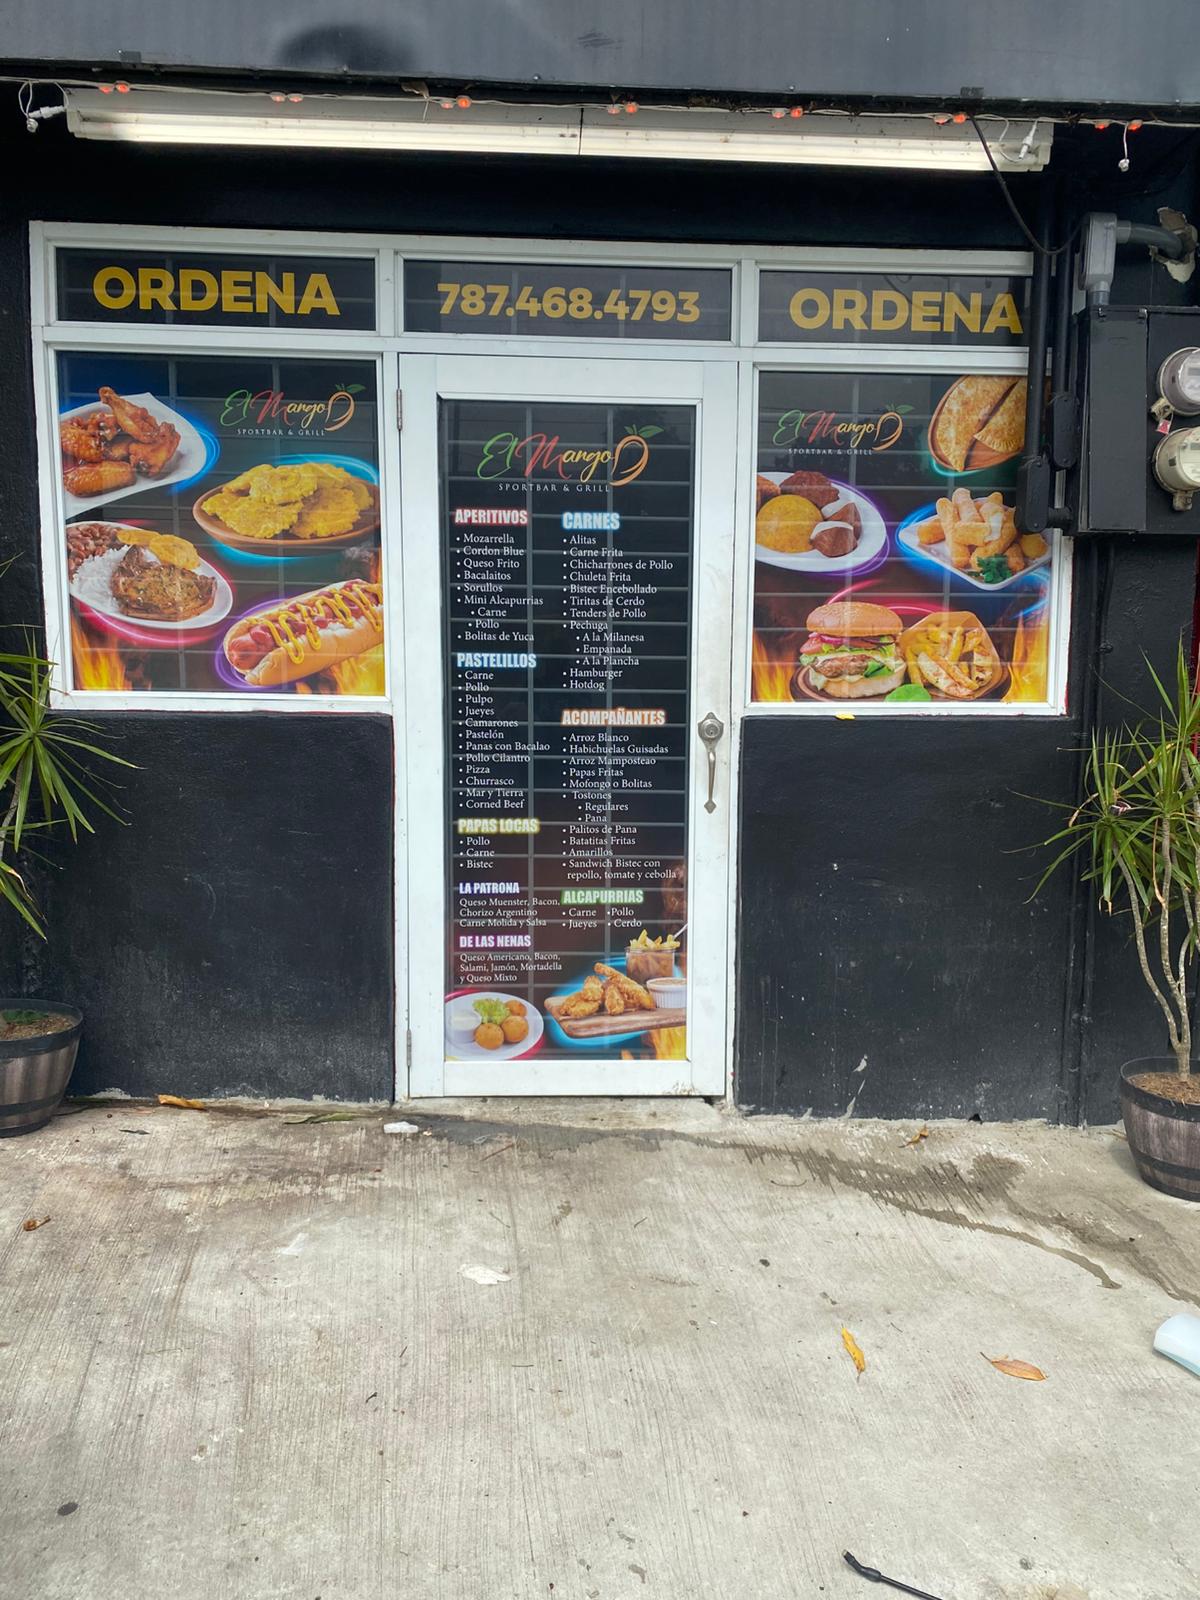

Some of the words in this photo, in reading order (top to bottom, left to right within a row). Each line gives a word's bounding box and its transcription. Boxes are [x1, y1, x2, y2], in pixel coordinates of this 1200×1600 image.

[93, 266, 340, 316] ORDENA
[437, 283, 700, 322] 787.468.4793
[789, 288, 1024, 334] ORDENA
[220, 389, 252, 426] El
[250, 390, 326, 429] Mango
[773, 409, 805, 446] El
[802, 410, 875, 448] Mango
[477, 432, 518, 480] El
[515, 433, 613, 482] Mango
[499, 483, 557, 491] SPORTBAR
[577, 484, 609, 492] GRILL
[455, 509, 528, 524] APERITIVOS
[562, 512, 620, 529] CARNES
[463, 534, 514, 543] Mozarrella
[570, 535, 596, 544] Alitas
[463, 546, 500, 555] Cordon
[503, 546, 524, 556] Blue
[570, 548, 598, 557] Carne
[602, 548, 623, 557] Frita
[463, 559, 494, 569] Queso
[497, 559, 520, 568] Frito
[570, 560, 632, 569] Chicharrones
[636, 561, 646, 569] de
[650, 560, 673, 569] Pollo
[464, 571, 511, 580] Bacalaitos
[570, 572, 606, 581] Chuleta
[610, 572, 631, 581] Frita
[464, 583, 503, 592] Sorullos
[570, 584, 597, 593] Bistec
[600, 585, 657, 594] Encebollado
[464, 595, 486, 604] Mini
[489, 596, 543, 607] Alcapurrias
[570, 596, 600, 605] Tiritas
[602, 597, 613, 605] de
[616, 597, 645, 606] Cerdo
[478, 607, 506, 616] Carne
[570, 609, 606, 618] Tenders
[609, 609, 620, 618] de
[623, 609, 646, 618] Pollo
[475, 620, 499, 628] Pollo
[570, 621, 608, 632] Pechuga
[465, 632, 496, 641] Bolitas
[499, 632, 510, 641] de
[512, 632, 534, 641] Yuca
[582, 634, 589, 642] A
[592, 633, 600, 642] la
[603, 633, 644, 642] Milanesa
[583, 645, 632, 655] Empanada
[457, 653, 537, 668] PASTELILLOS
[592, 657, 600, 665] la
[603, 657, 639, 666] Plancha
[465, 671, 494, 679] Carne
[570, 668, 623, 679] Hamburger
[465, 683, 489, 691] Pollo
[570, 680, 605, 691] Hotdog
[465, 694, 493, 706] Pulpo
[465, 706, 494, 717] Jueyes
[562, 707, 665, 726] ACOMPAÑANTES
[465, 719, 518, 727] Camarones
[466, 730, 504, 739] Pastelón
[569, 733, 595, 742] Arroz
[598, 733, 629, 742] Blanco
[466, 742, 493, 750] Panas
[515, 742, 550, 751] Bacalao
[569, 745, 625, 753] Habichuelas
[627, 745, 668, 753] Guisadas
[466, 754, 489, 762] Pollo
[492, 753, 530, 762] Cilantro
[569, 757, 595, 765] Arroz
[598, 756, 656, 767] Mamposteao
[466, 765, 490, 773] Pizza
[570, 768, 595, 778] Papas
[598, 768, 624, 776] Fritas
[466, 777, 514, 785] Churrasco
[570, 780, 611, 790] Mofongo
[622, 779, 652, 788] Bolitas
[466, 789, 485, 797] Mar
[488, 791, 493, 799] y
[496, 789, 523, 797] Tierra
[572, 791, 611, 799] Tostones
[466, 800, 501, 809] Corned
[504, 799, 525, 809] Beef
[585, 802, 628, 813] Regulares
[585, 814, 607, 822] Pana
[458, 819, 497, 833] PAPAS
[500, 819, 539, 833] LOCAS
[570, 825, 599, 833] Palitos
[602, 825, 612, 833] de
[615, 825, 637, 833] Pana
[466, 837, 490, 846] Pollo
[570, 837, 608, 845] Batatitas
[611, 836, 636, 845] Fritas
[466, 849, 495, 857] Carne
[569, 848, 613, 856] Amarillos
[466, 860, 493, 868] Bistec
[569, 859, 612, 868] Sandwich
[615, 859, 641, 867] Bistec
[568, 870, 601, 881] repollo,
[605, 871, 635, 879] tomate
[637, 872, 642, 880] y
[645, 870, 676, 879] cebolla
[459, 882, 472, 894] LA
[474, 882, 520, 894] PATRONA
[563, 890, 644, 904] ALCAPURRIAS
[460, 898, 486, 908] Queso
[489, 898, 530, 907] Muenster,
[532, 898, 560, 906] Bacon,
[460, 909, 494, 917] Chorizo
[496, 909, 537, 918] Argentino
[569, 908, 596, 916] Carne
[611, 907, 634, 916] Pollo
[460, 919, 485, 927] Carne
[488, 919, 517, 927] Molida
[520, 920, 524, 928] y
[526, 918, 547, 926] Salsa
[569, 919, 597, 930] Jueyes
[614, 919, 642, 927] Cerdo
[460, 936, 473, 947] DE
[475, 936, 494, 947] LAS
[497, 936, 531, 947] NENAS
[460, 953, 485, 963] Queso
[487, 953, 531, 962] Americano,
[534, 952, 560, 961] Bacon,
[460, 964, 489, 972] Salami,
[491, 963, 518, 972] Jamón,
[520, 963, 562, 971] Mortadella
[460, 976, 464, 984] y
[467, 974, 492, 983] Queso
[494, 974, 517, 982] Mixto
